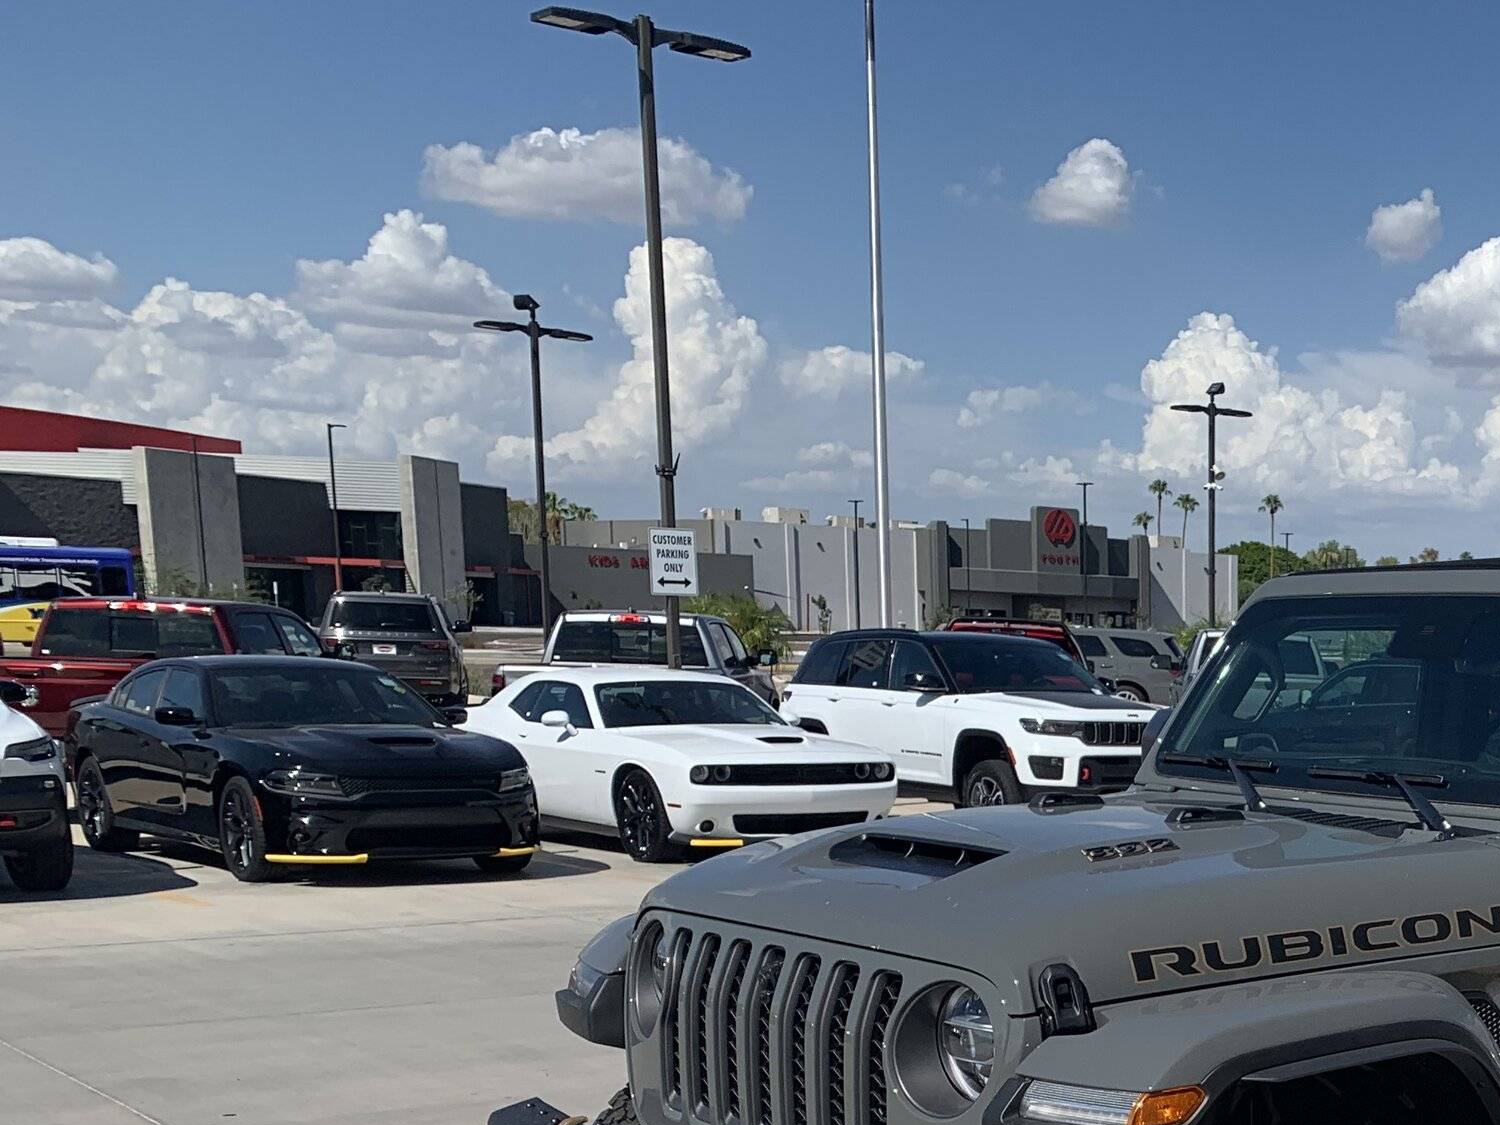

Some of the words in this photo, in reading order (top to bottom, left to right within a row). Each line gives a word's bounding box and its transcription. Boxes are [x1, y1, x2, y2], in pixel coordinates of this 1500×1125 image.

[652, 534, 692, 545] CUSTOMER
[656, 549, 689, 559] PARKING
[663, 562, 684, 573] ONLY
